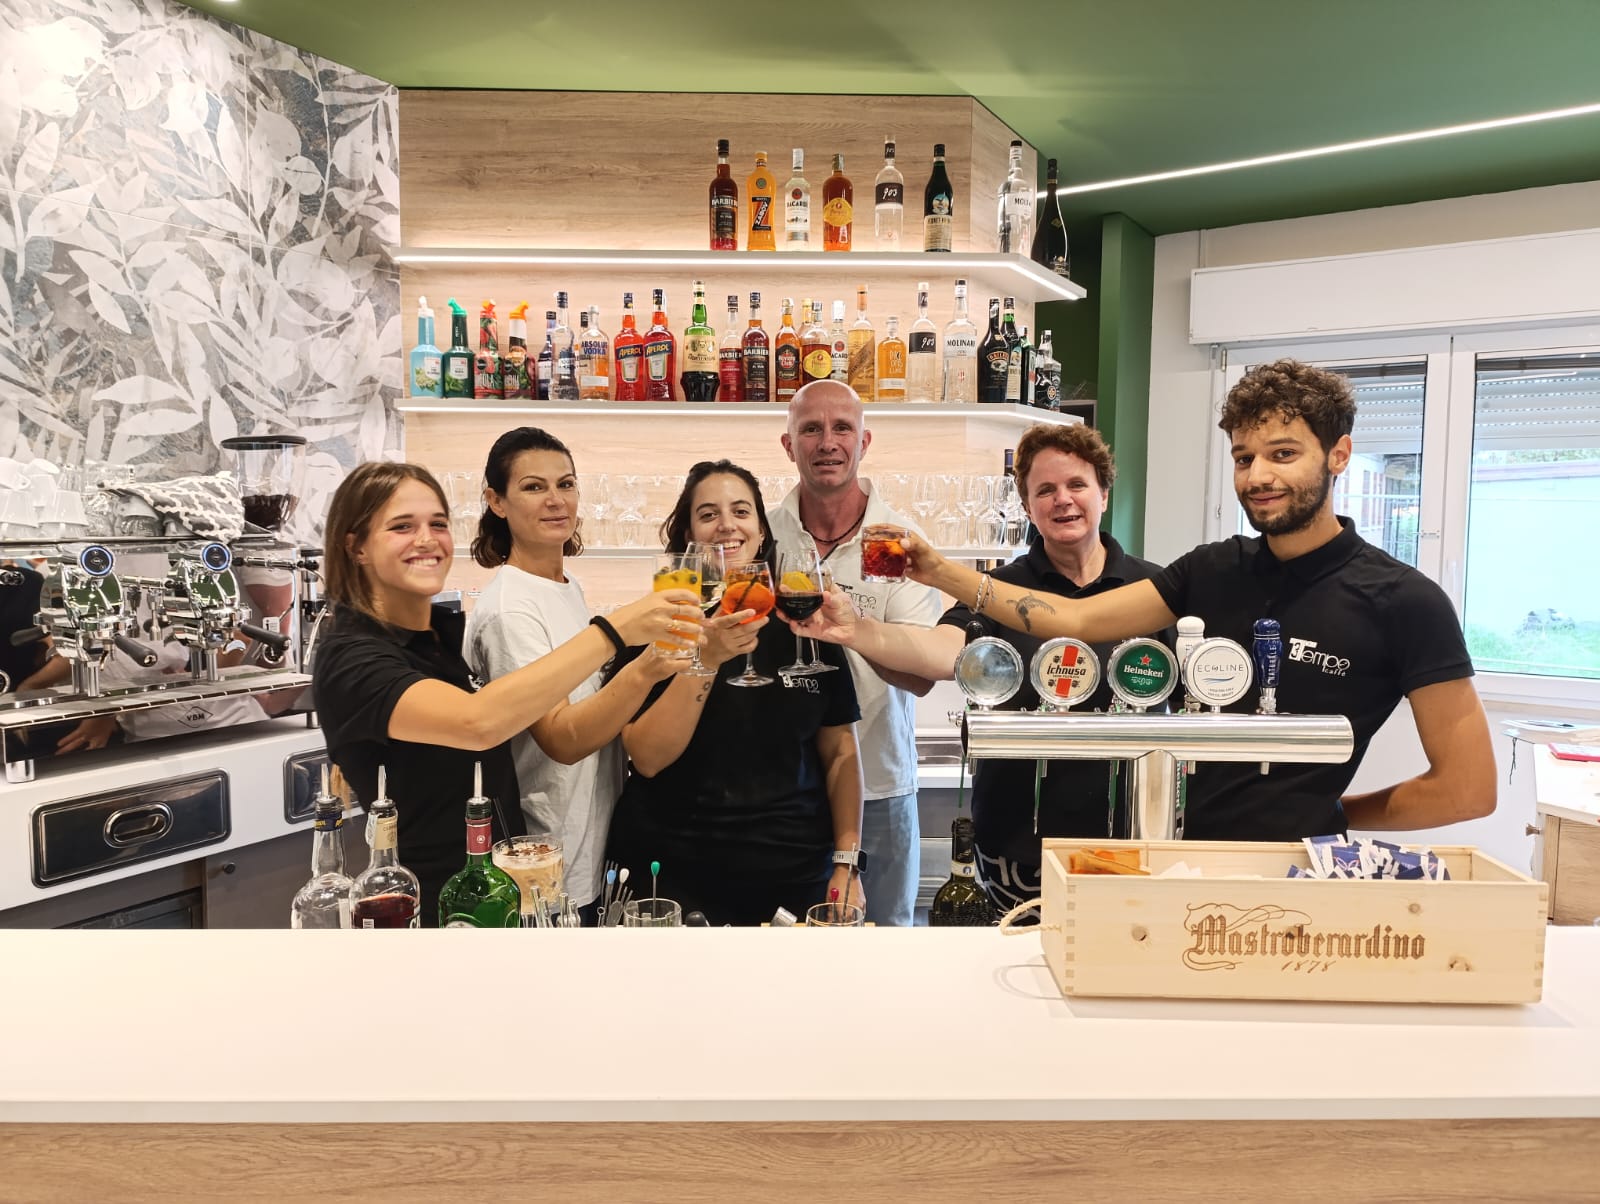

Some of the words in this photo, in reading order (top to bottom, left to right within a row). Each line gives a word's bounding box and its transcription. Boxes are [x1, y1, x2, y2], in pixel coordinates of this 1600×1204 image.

[619, 347, 642, 357] APEROL
[647, 343, 669, 355] APEROL
[1123, 664, 1163, 678] Heineken
[1191, 914, 1426, 960] Mastroberardino
[1281, 960, 1337, 974] 1878
